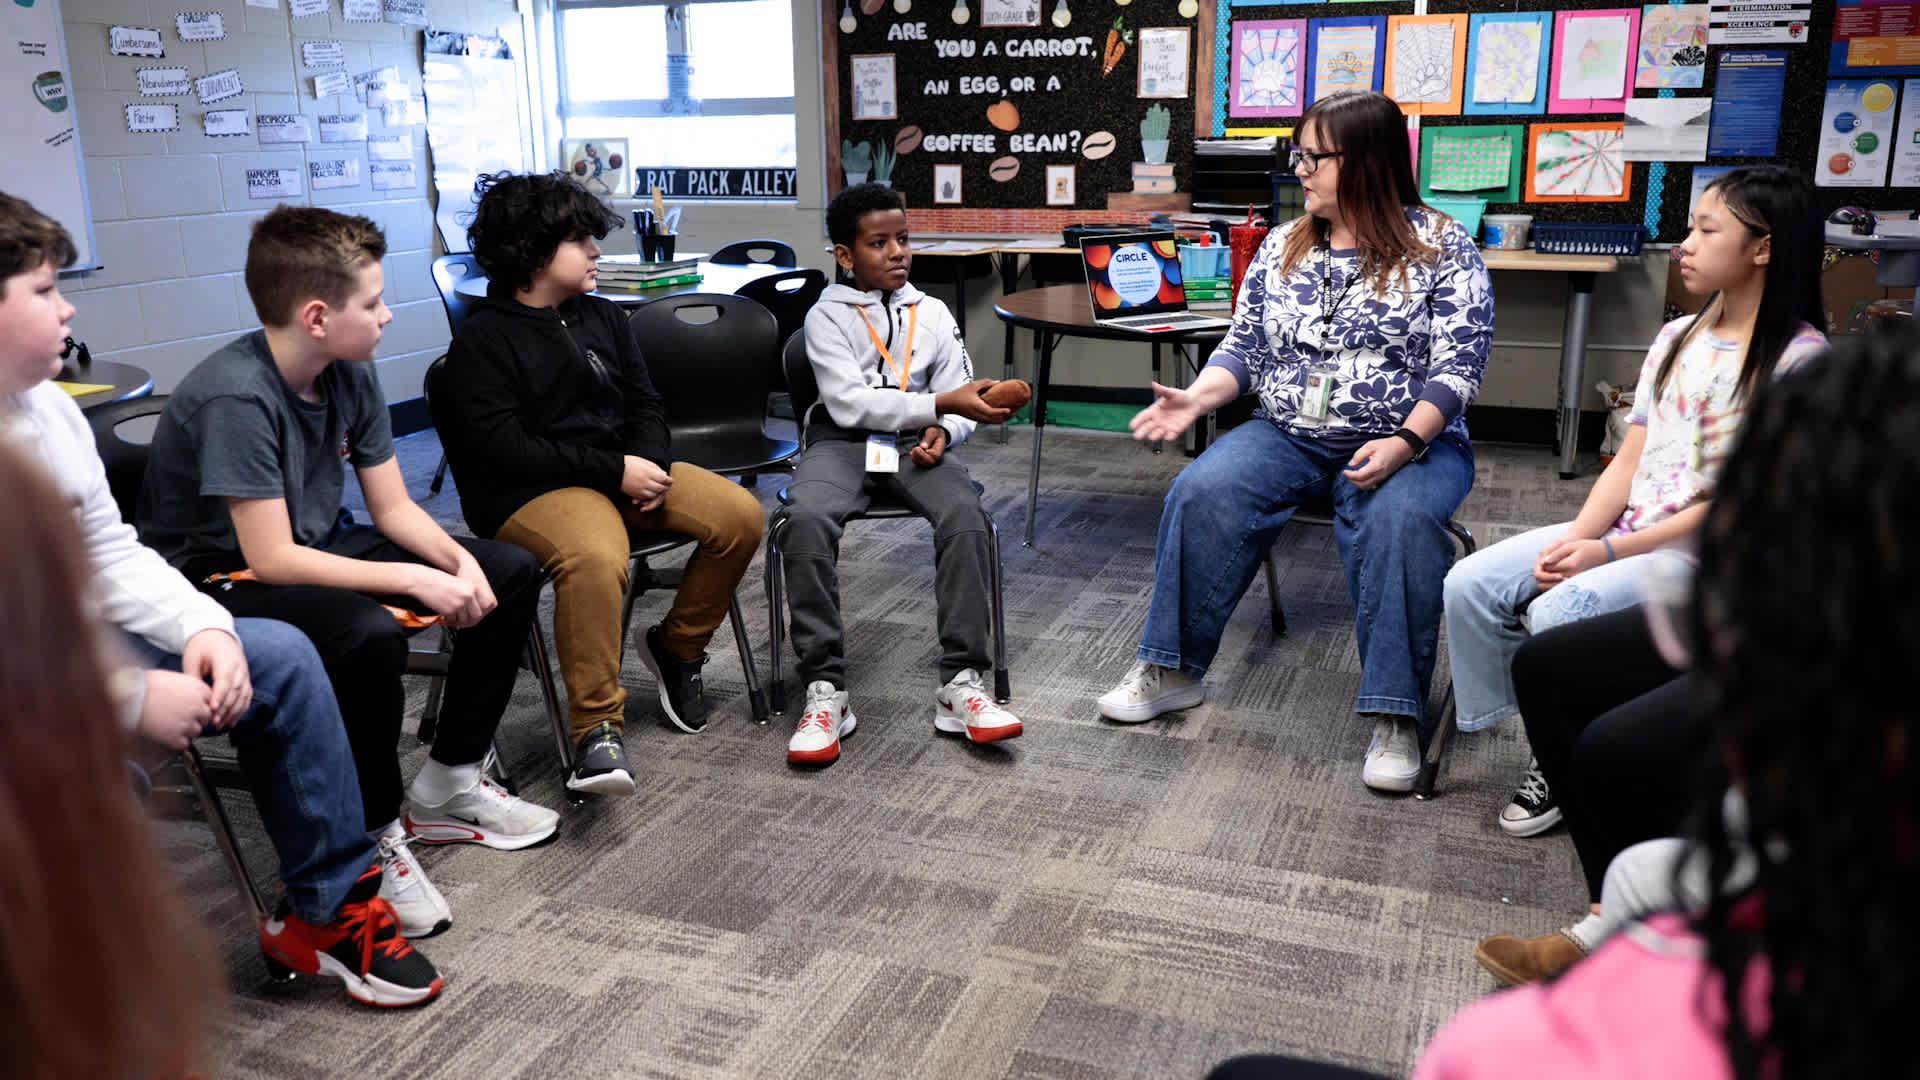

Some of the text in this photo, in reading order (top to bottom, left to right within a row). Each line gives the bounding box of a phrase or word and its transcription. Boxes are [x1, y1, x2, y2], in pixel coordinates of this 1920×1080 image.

[887, 22, 928, 41] ARE
[934, 36, 1097, 60] YOU A CARROT,
[923, 75, 1061, 97] AN EGG, OR A
[45, 87, 62, 97] WHY
[256, 114, 296, 124] RECIPROCAL
[319, 115, 340, 124] MIXED
[923, 130, 1082, 153] COFFEE BEAN?
[247, 169, 279, 178] IMPROPER
[248, 178, 281, 186] FRACTION
[647, 170, 796, 195] RAT PACK ALLEY
[1115, 252, 1148, 263] CIRCLE
